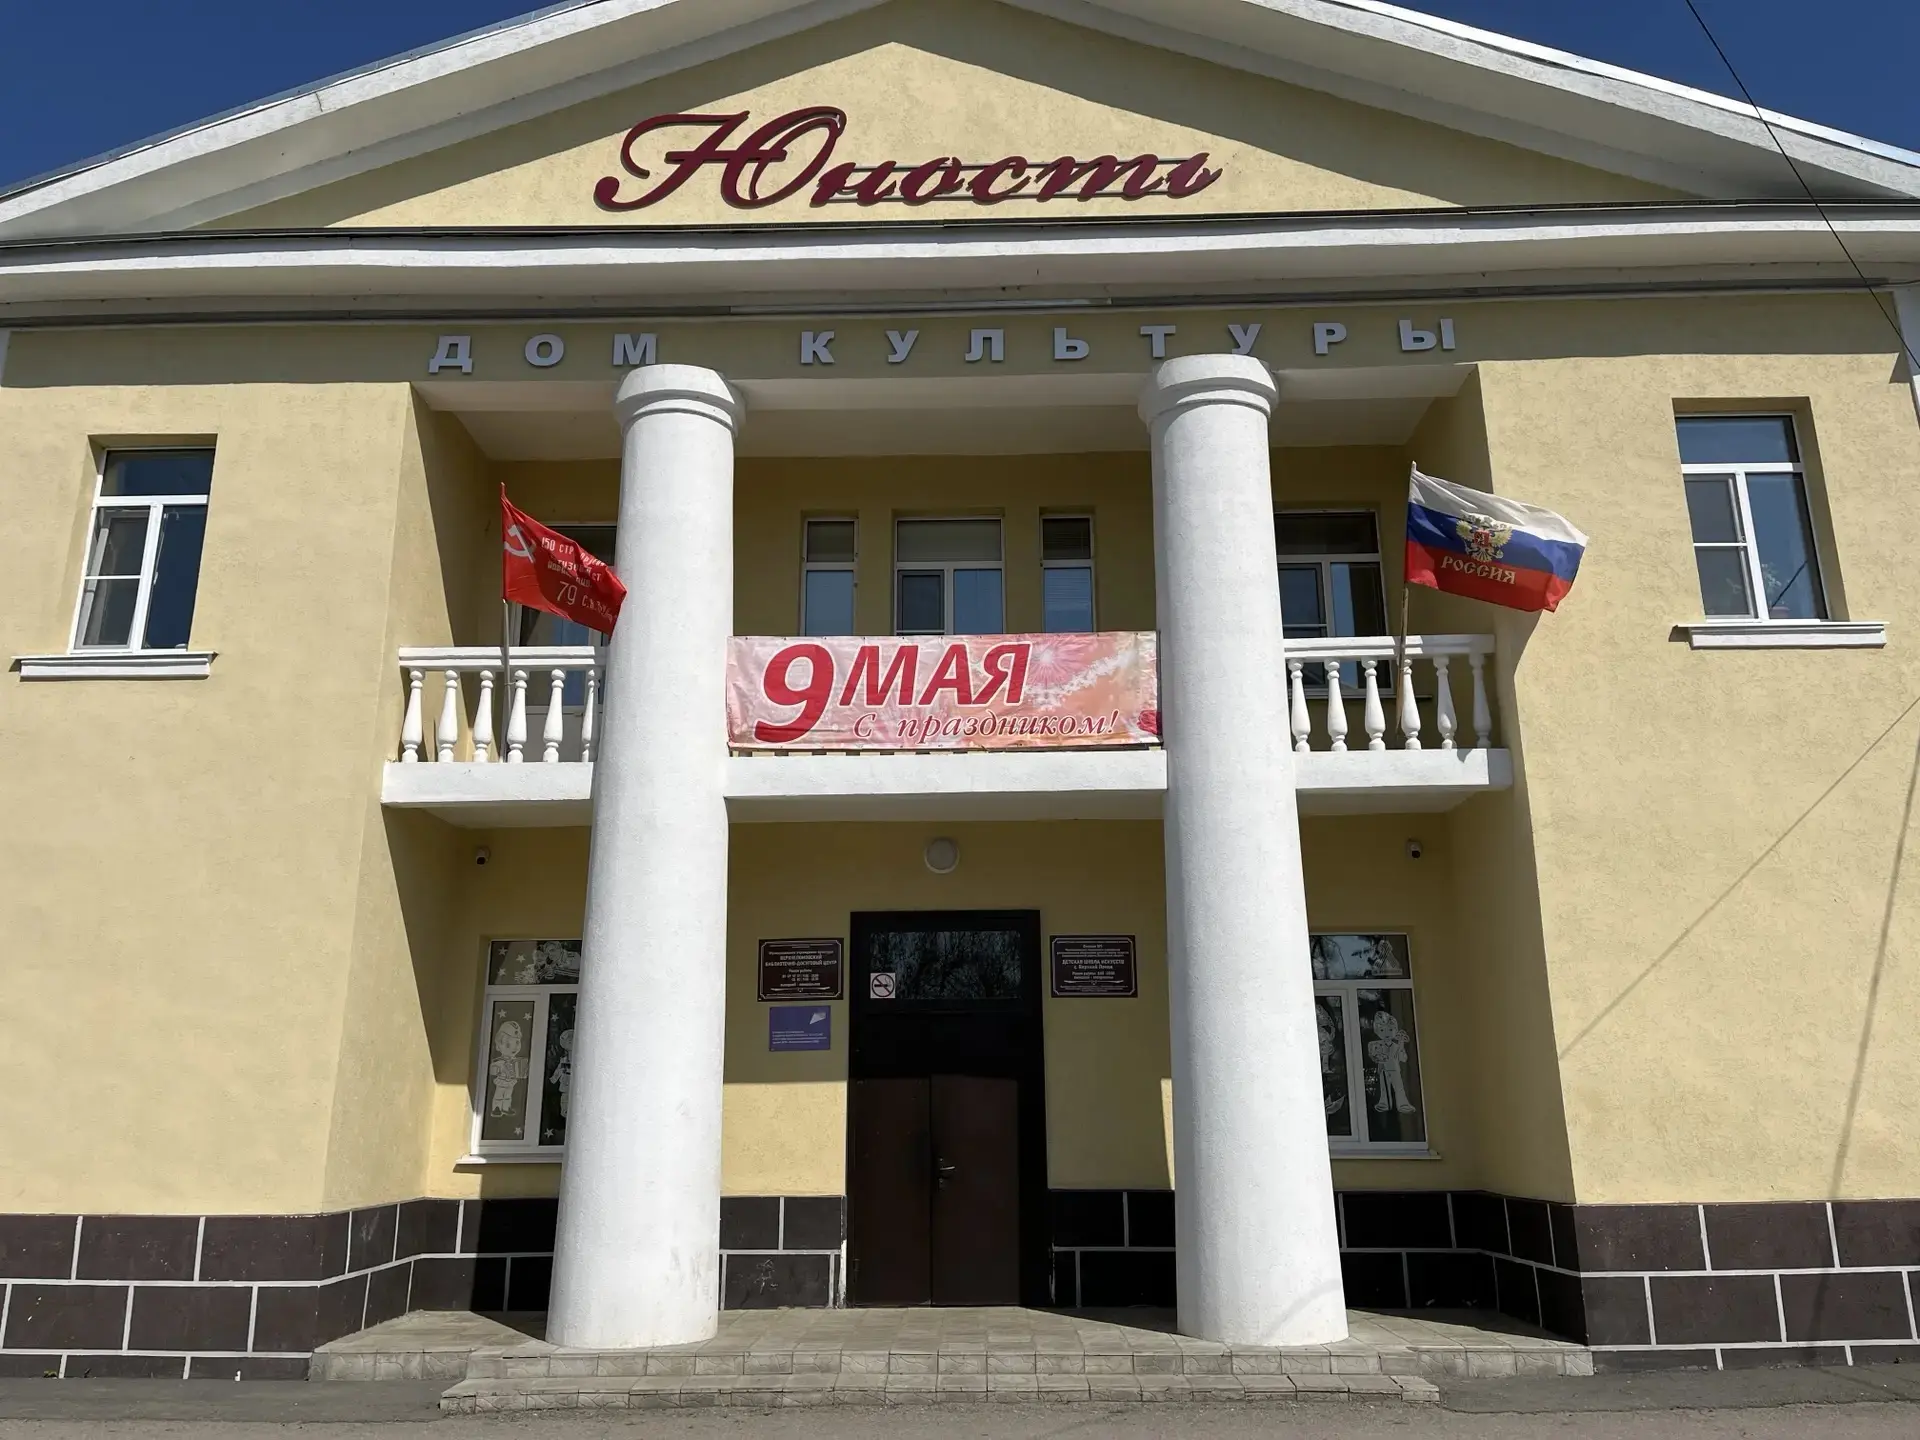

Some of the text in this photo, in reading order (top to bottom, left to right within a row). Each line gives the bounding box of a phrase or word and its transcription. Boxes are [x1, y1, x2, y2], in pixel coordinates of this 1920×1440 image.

[594, 106, 1223, 212] Юность
[428, 318, 1456, 374] ДОМ КУЛЬТУРЫ
[541, 536, 556, 552] 150
[1441, 556, 1516, 584] РОССИЯ
[557, 581, 577, 606] 79
[753, 641, 1032, 744] 9 МАЯ
[853, 709, 1120, 744] С праздником!
